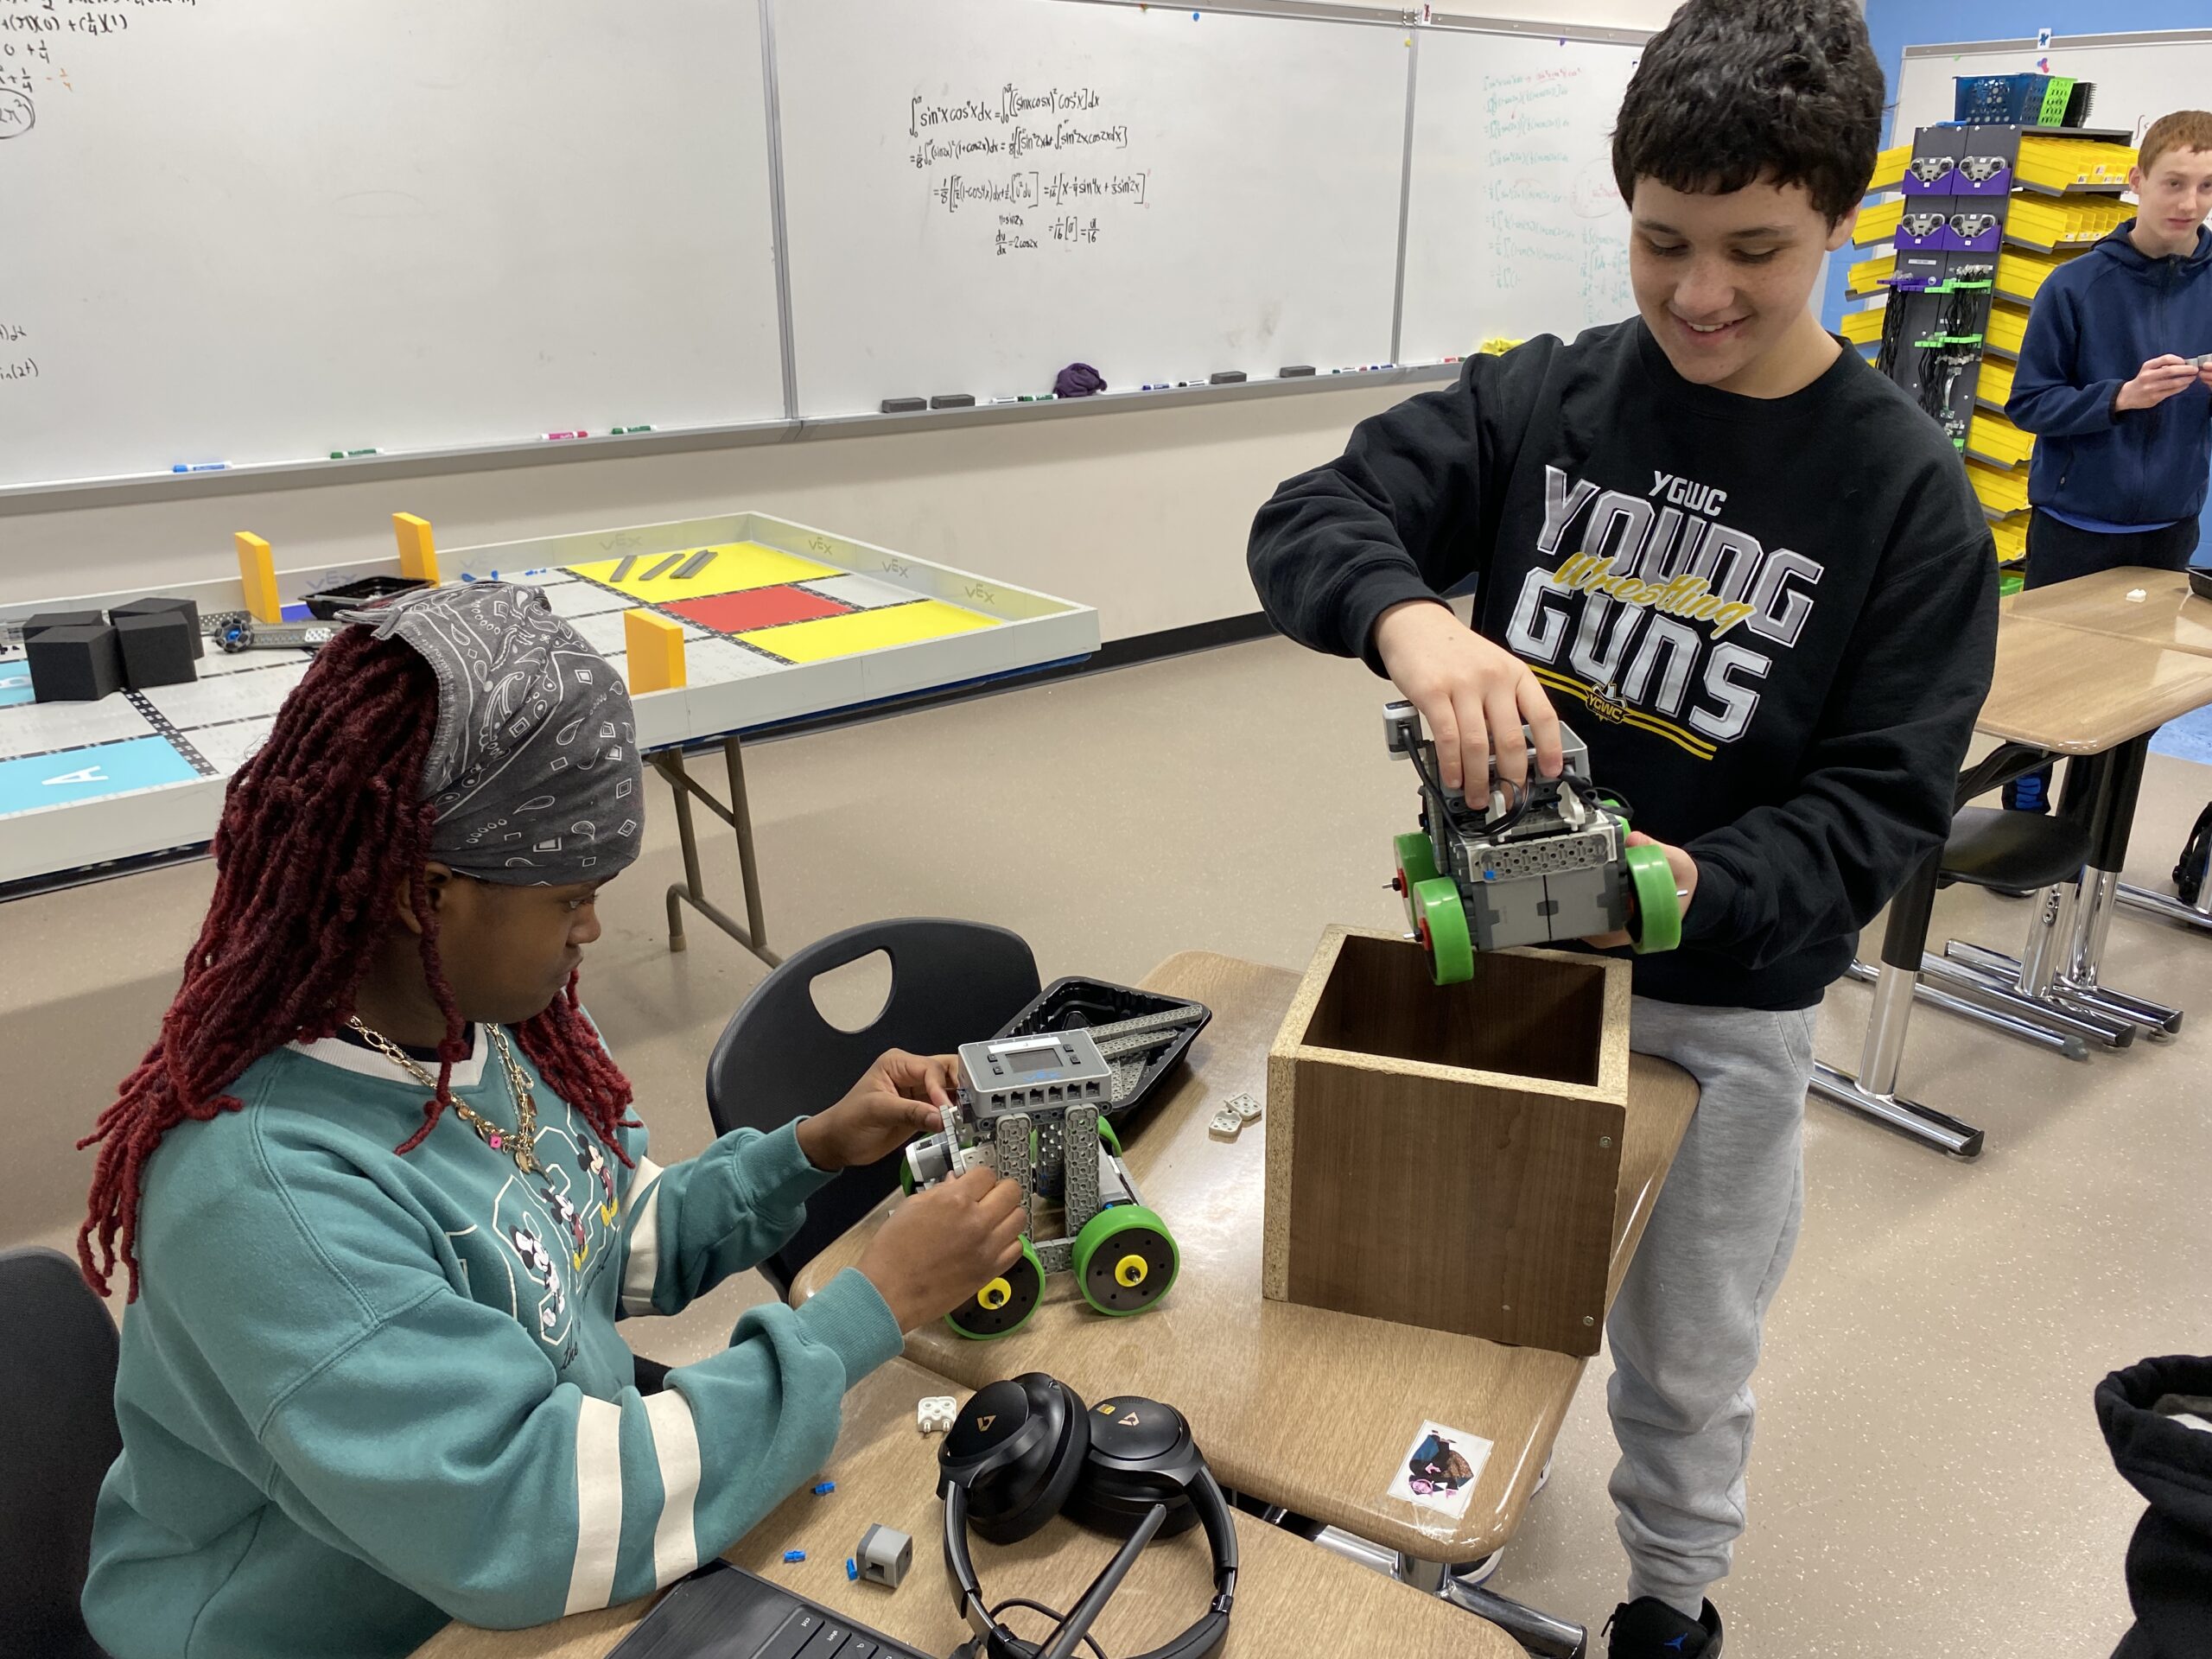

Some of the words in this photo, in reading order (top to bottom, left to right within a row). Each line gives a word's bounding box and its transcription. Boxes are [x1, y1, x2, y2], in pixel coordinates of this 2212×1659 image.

[1648, 470, 1726, 517] YGWC
[808, 537, 833, 555] VEX
[1536, 464, 1825, 648] YOUNG
[881, 558, 909, 578] VEX
[964, 583, 995, 605] VEX
[1552, 551, 1757, 639] Wrestling
[1505, 566, 1772, 743] GUNS
[1590, 694, 1623, 720] YGWC
